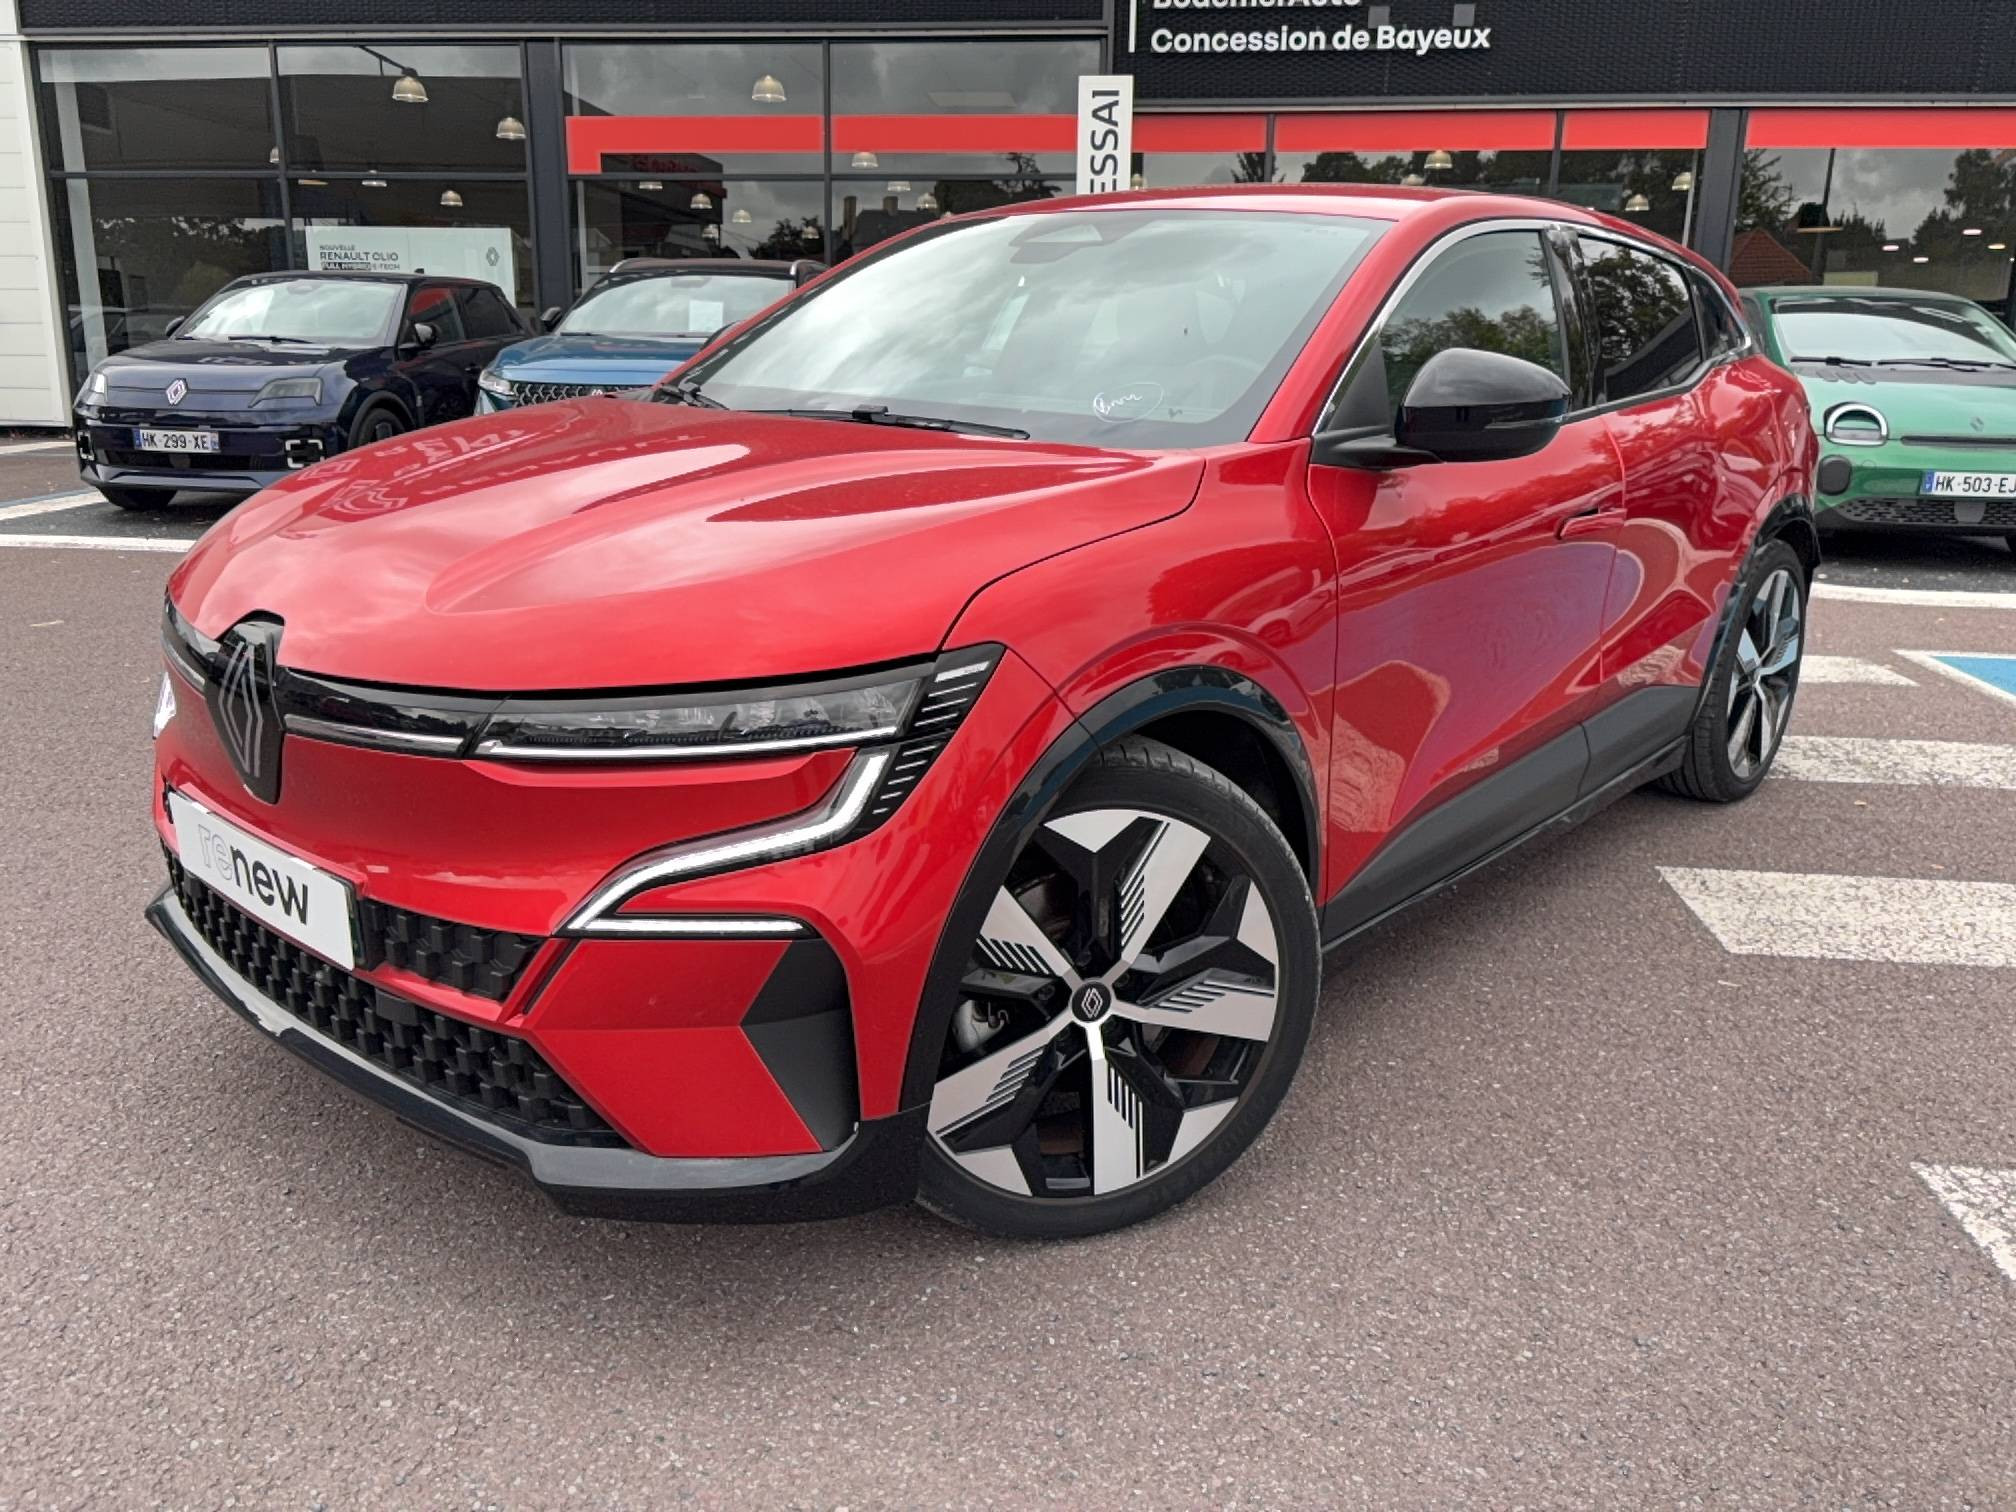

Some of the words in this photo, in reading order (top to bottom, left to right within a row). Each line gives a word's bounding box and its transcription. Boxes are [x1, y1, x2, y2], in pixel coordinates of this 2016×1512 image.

[1151, 26, 1326, 53] Concession
[1332, 25, 1370, 50] de
[1376, 25, 1491, 55] Bayeux
[1090, 90, 1120, 194] ESSAI
[319, 251, 371, 261] RENAULT
[198, 823, 309, 926] renew
